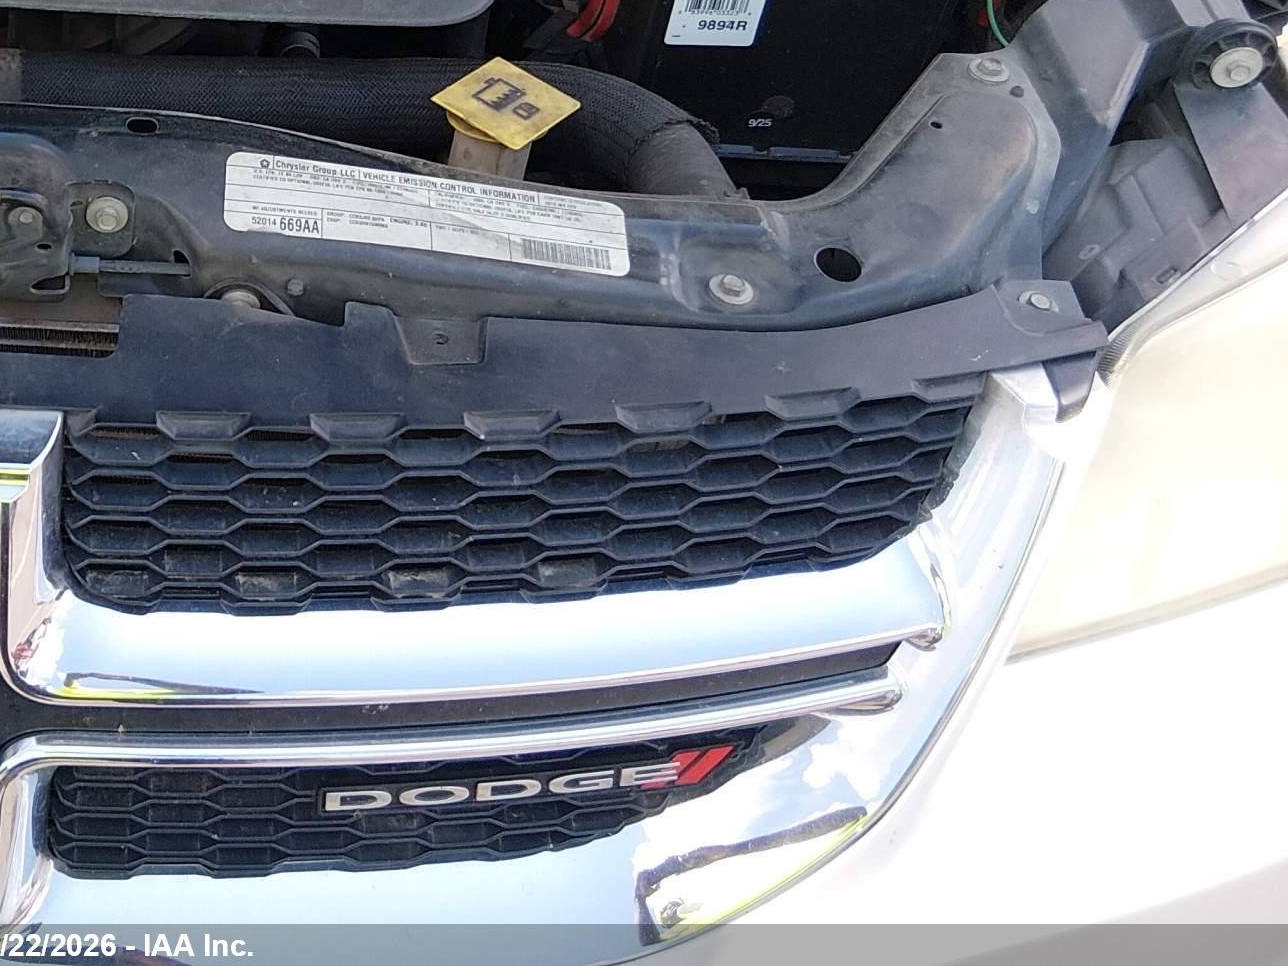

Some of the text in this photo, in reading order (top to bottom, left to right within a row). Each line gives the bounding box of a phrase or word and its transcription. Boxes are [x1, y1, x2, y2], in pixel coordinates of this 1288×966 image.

[697, 20, 748, 31] 9894R
[748, 118, 773, 127] 9/25
[275, 159, 310, 172] Chrysler
[312, 165, 337, 177] Group
[340, 169, 356, 178] LLC
[363, 172, 396, 184] VEHICLE
[399, 176, 437, 189] EMISSION
[440, 182, 477, 195] CONTROL
[480, 188, 536, 203] INFORMATION
[252, 216, 277, 227] 52014
[279, 217, 320, 234] 669AA
[325, 761, 681, 812] DODGE
